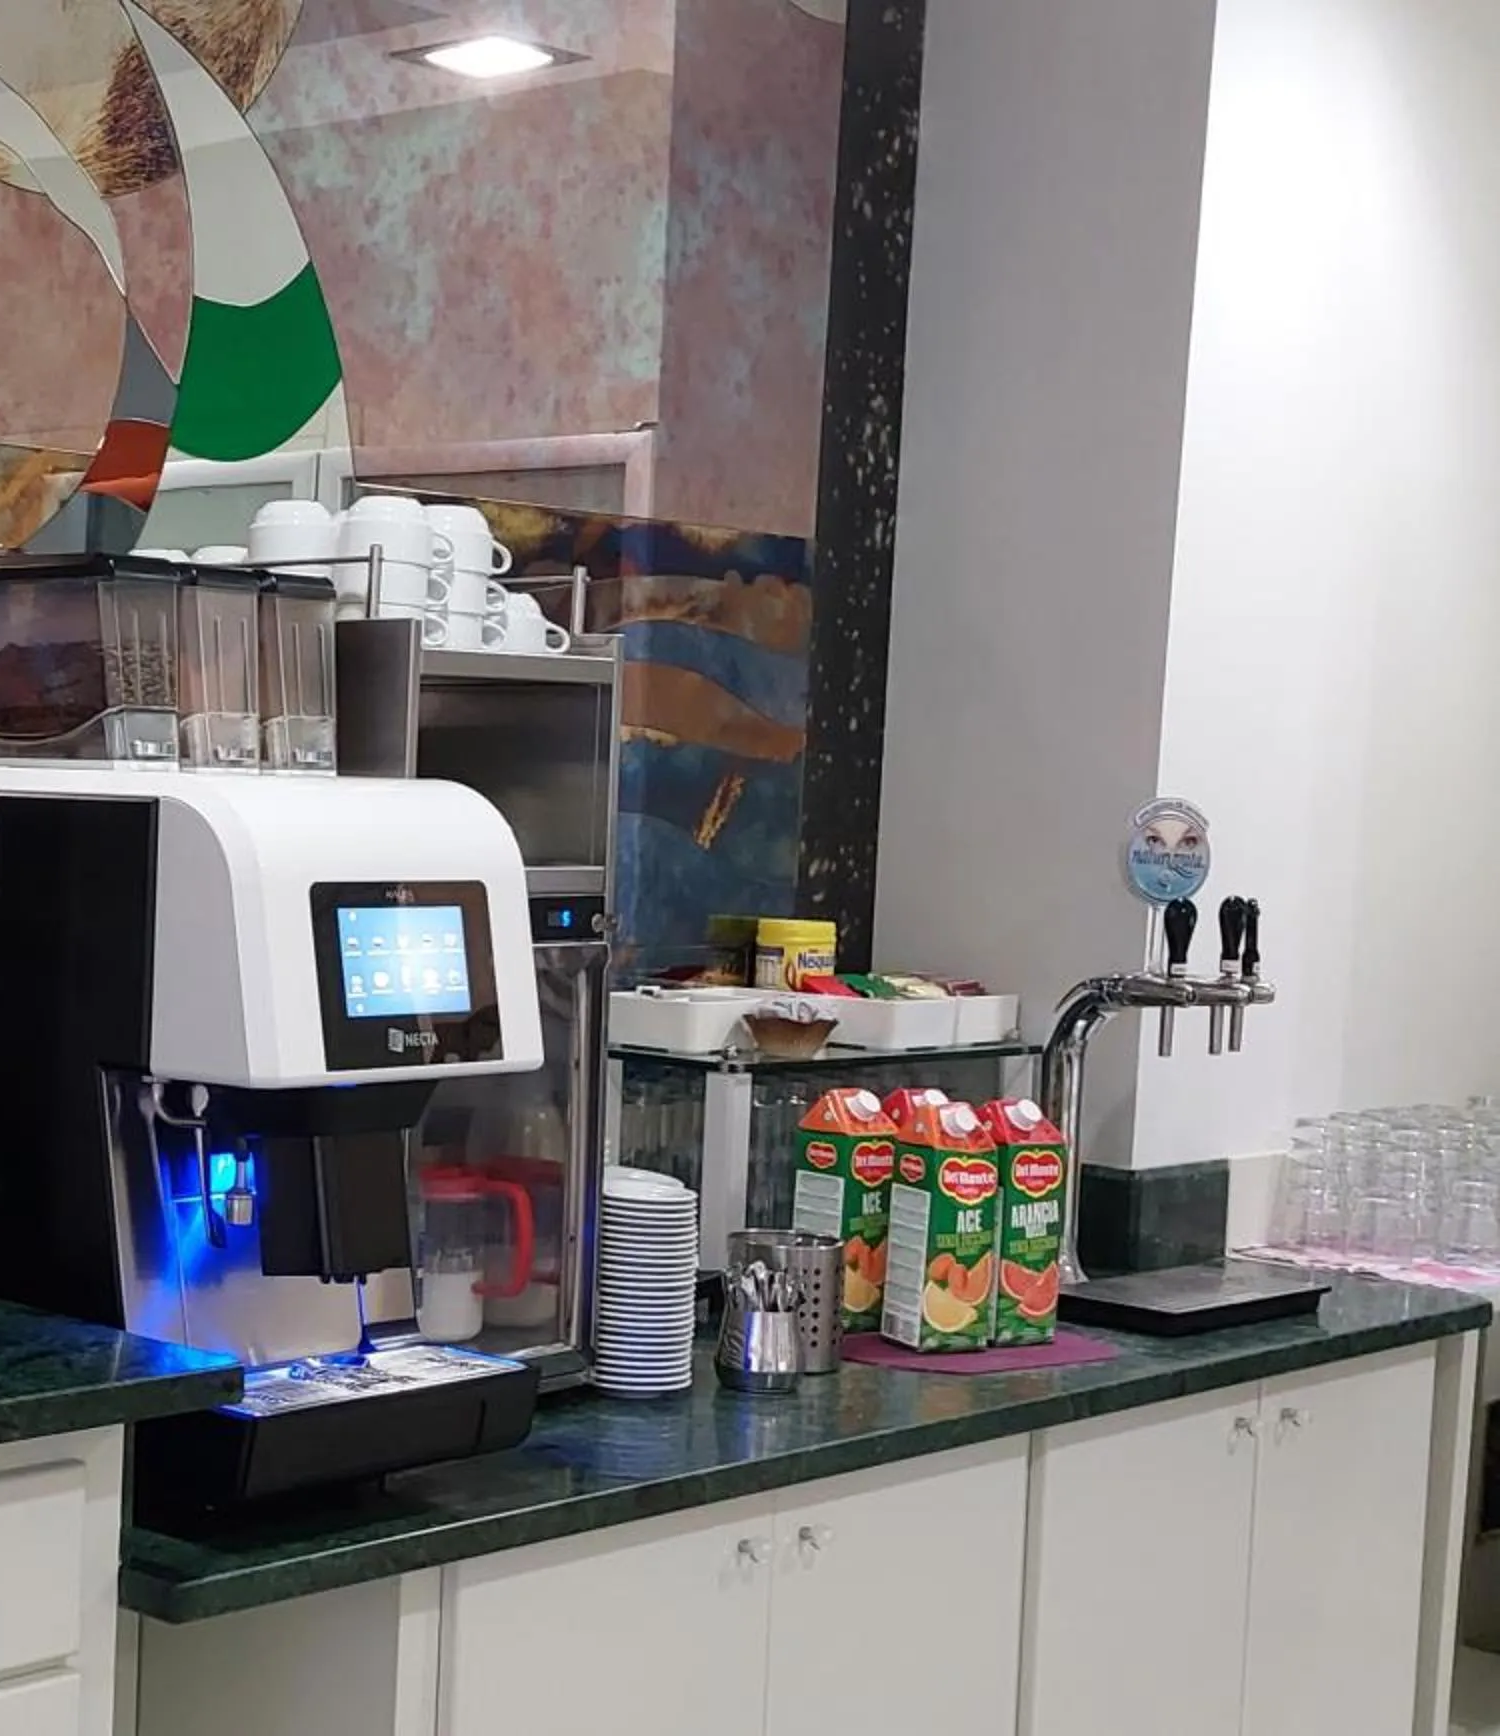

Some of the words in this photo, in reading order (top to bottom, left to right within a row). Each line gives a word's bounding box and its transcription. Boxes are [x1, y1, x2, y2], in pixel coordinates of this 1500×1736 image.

[405, 1031, 440, 1047] NECTA
[862, 1191, 882, 1215] ACE
[1011, 1199, 1059, 1229] ARANCIA
[956, 1208, 983, 1233] ACE
